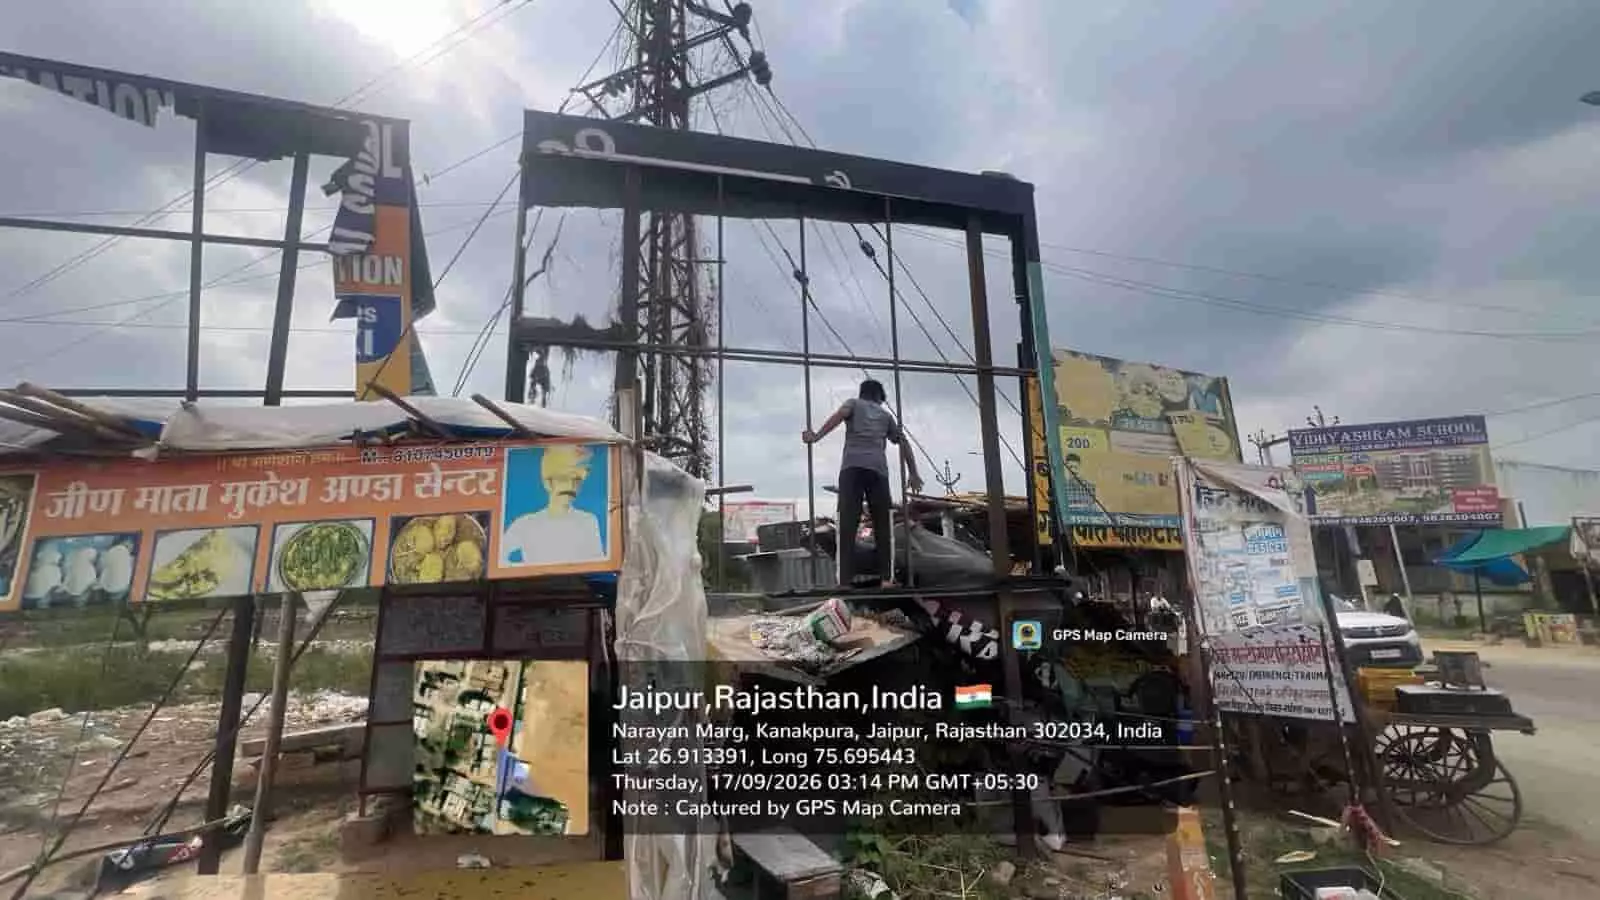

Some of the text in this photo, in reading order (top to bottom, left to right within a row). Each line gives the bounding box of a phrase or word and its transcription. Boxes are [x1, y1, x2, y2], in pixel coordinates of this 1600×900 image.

[1415, 422, 1482, 440] SCHOOL
[45, 463, 498, 520] जीण माता मुकेश अण्डा सेन्टर
